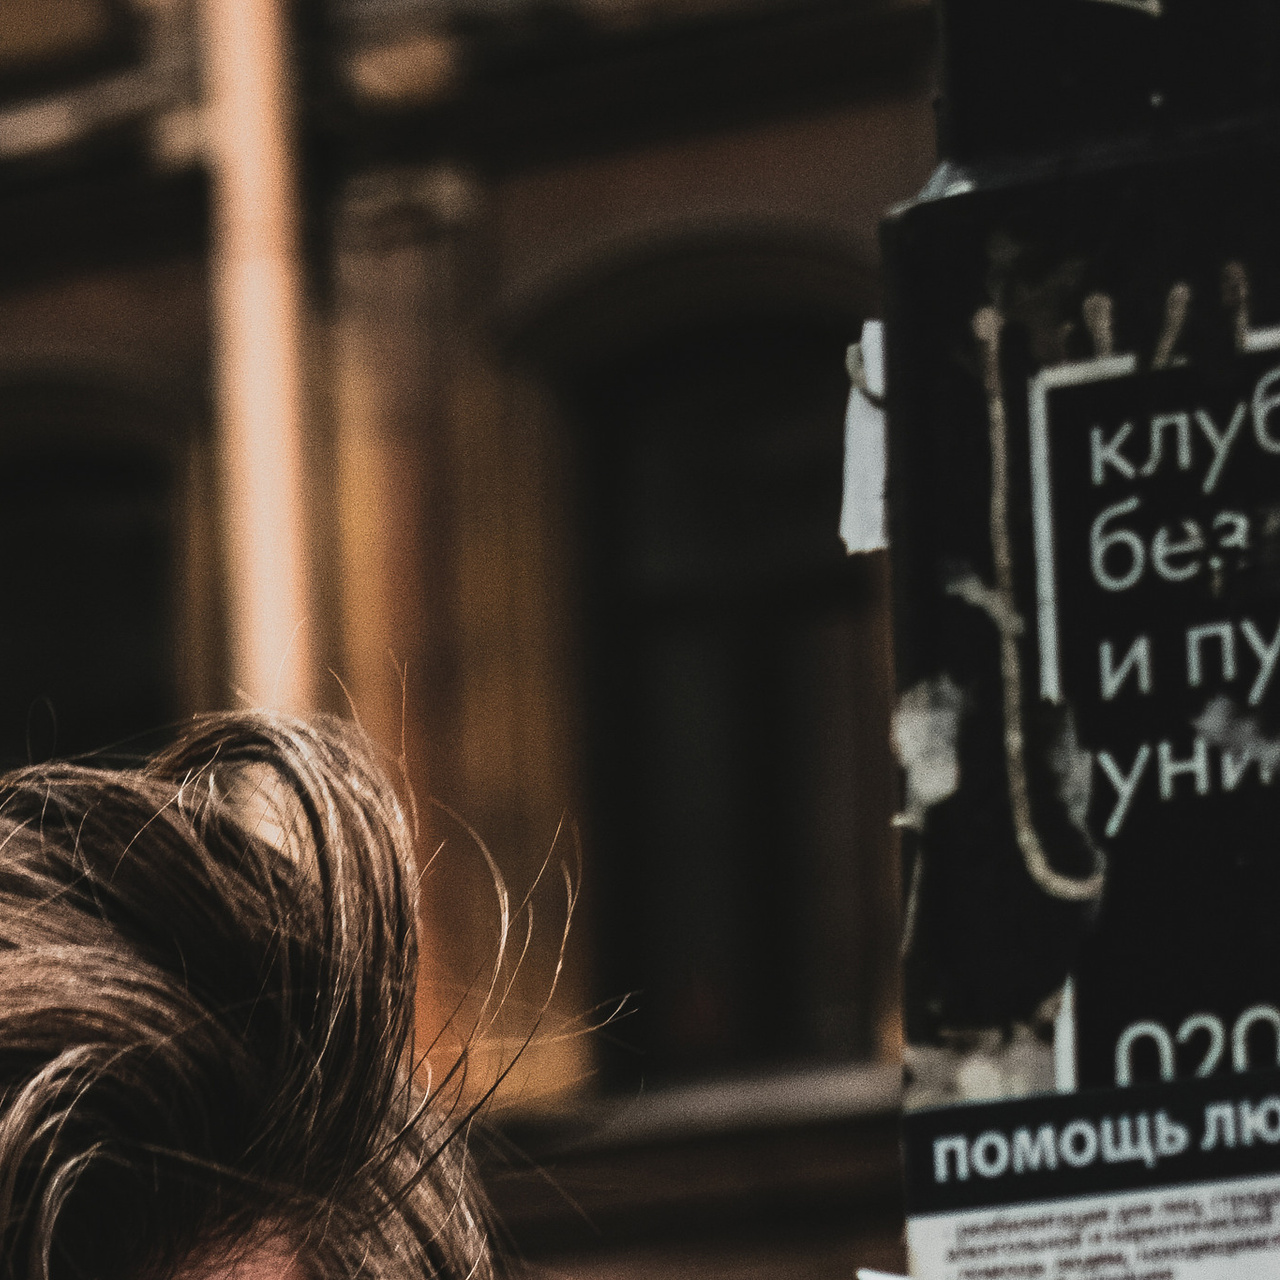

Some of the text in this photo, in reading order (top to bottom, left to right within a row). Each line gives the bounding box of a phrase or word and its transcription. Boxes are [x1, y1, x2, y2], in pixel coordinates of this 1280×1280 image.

[1098, 619, 1280, 705] и пу
[932, 1096, 1280, 1184] помощь лю
